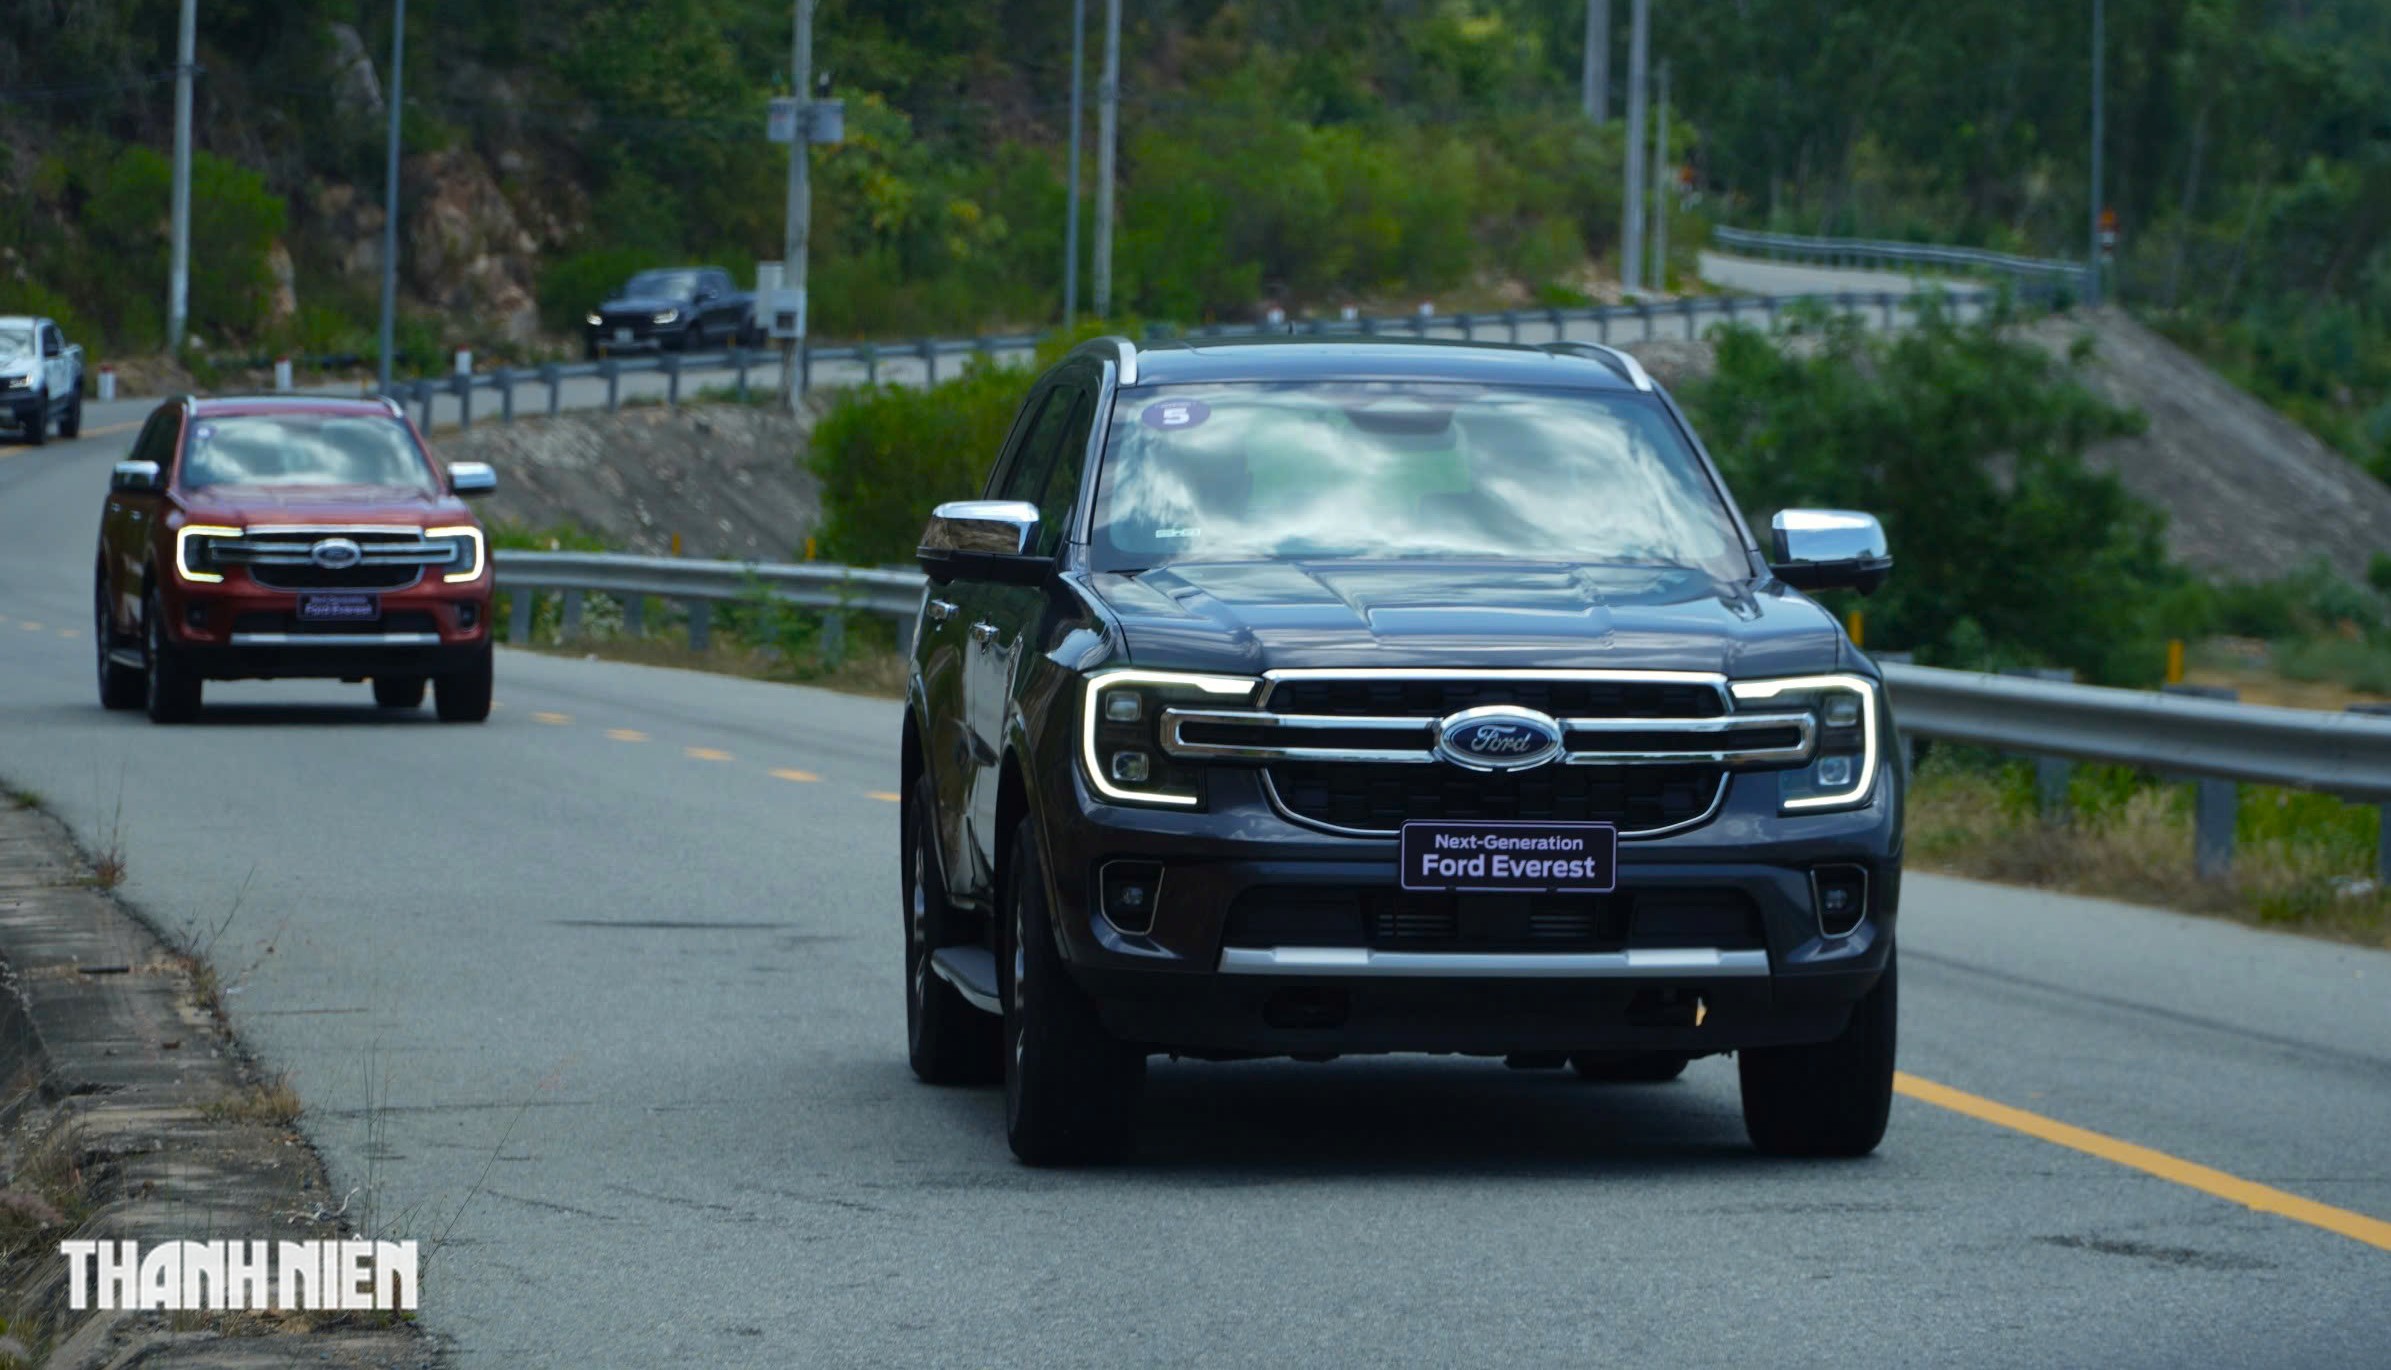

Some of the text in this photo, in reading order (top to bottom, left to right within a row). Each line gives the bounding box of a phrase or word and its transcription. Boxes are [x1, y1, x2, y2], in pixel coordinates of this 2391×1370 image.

[1163, 407, 1190, 425] 5
[1471, 724, 1532, 752] Ford
[1435, 834, 1583, 850] Next-Generation
[1422, 853, 1595, 878] Ford Everest
